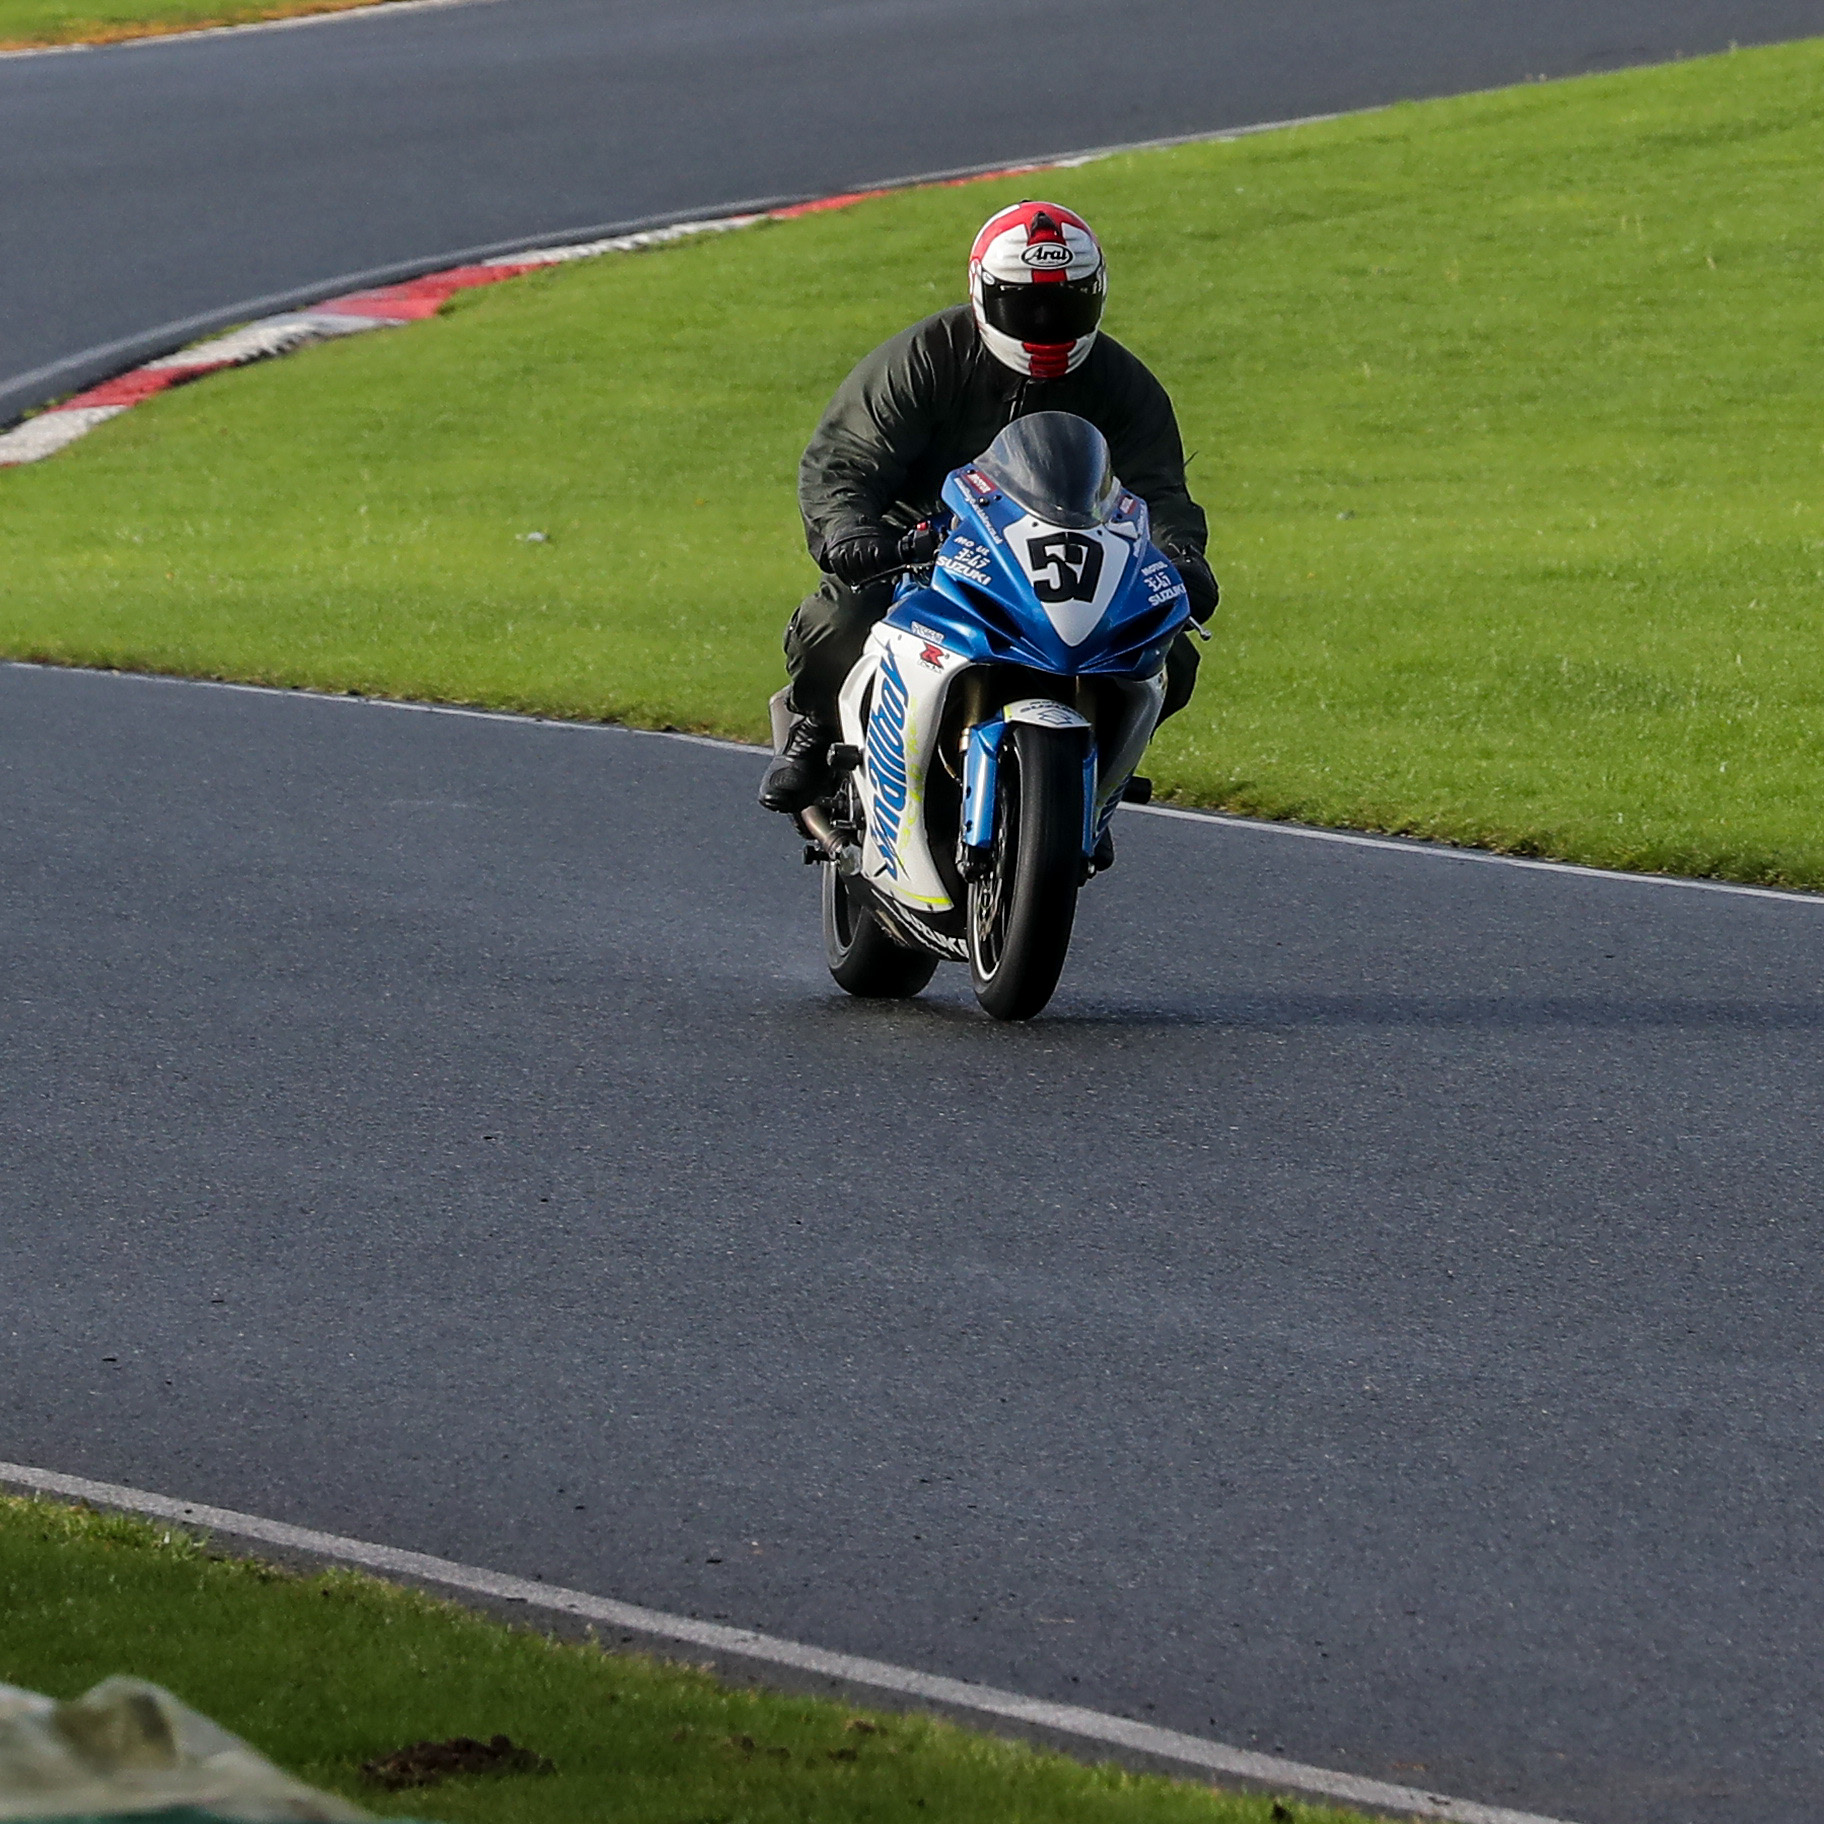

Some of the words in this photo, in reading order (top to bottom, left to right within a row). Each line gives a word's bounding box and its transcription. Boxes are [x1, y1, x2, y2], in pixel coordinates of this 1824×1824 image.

[1026, 246, 1068, 261] Arai
[935, 555, 992, 586] SUZUKI
[1147, 582, 1187, 607] SUZUKI
[892, 899, 970, 959] SUZUKI
